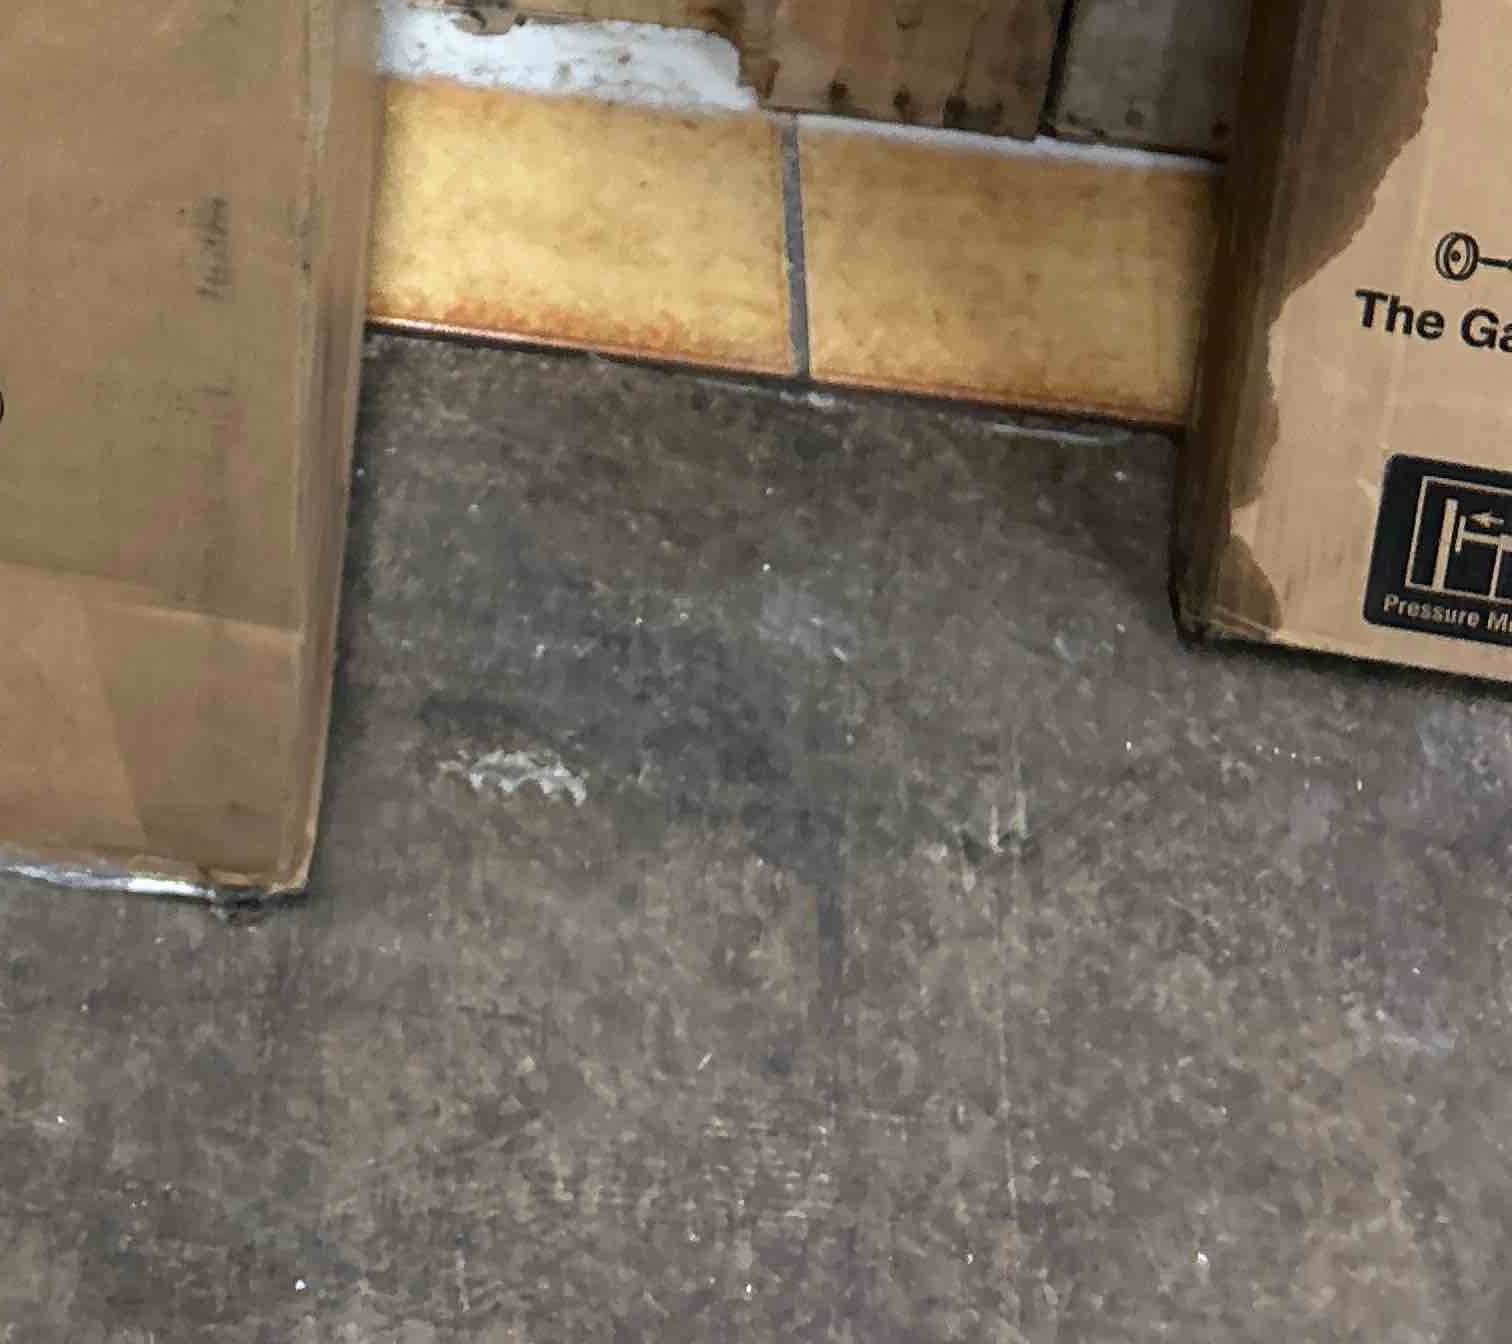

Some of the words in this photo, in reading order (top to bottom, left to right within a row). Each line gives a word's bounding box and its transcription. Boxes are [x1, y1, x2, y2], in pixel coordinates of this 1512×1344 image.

[1355, 288, 1445, 340] The
[1383, 592, 1481, 630] Pressure
[1486, 609, 1512, 633] M
